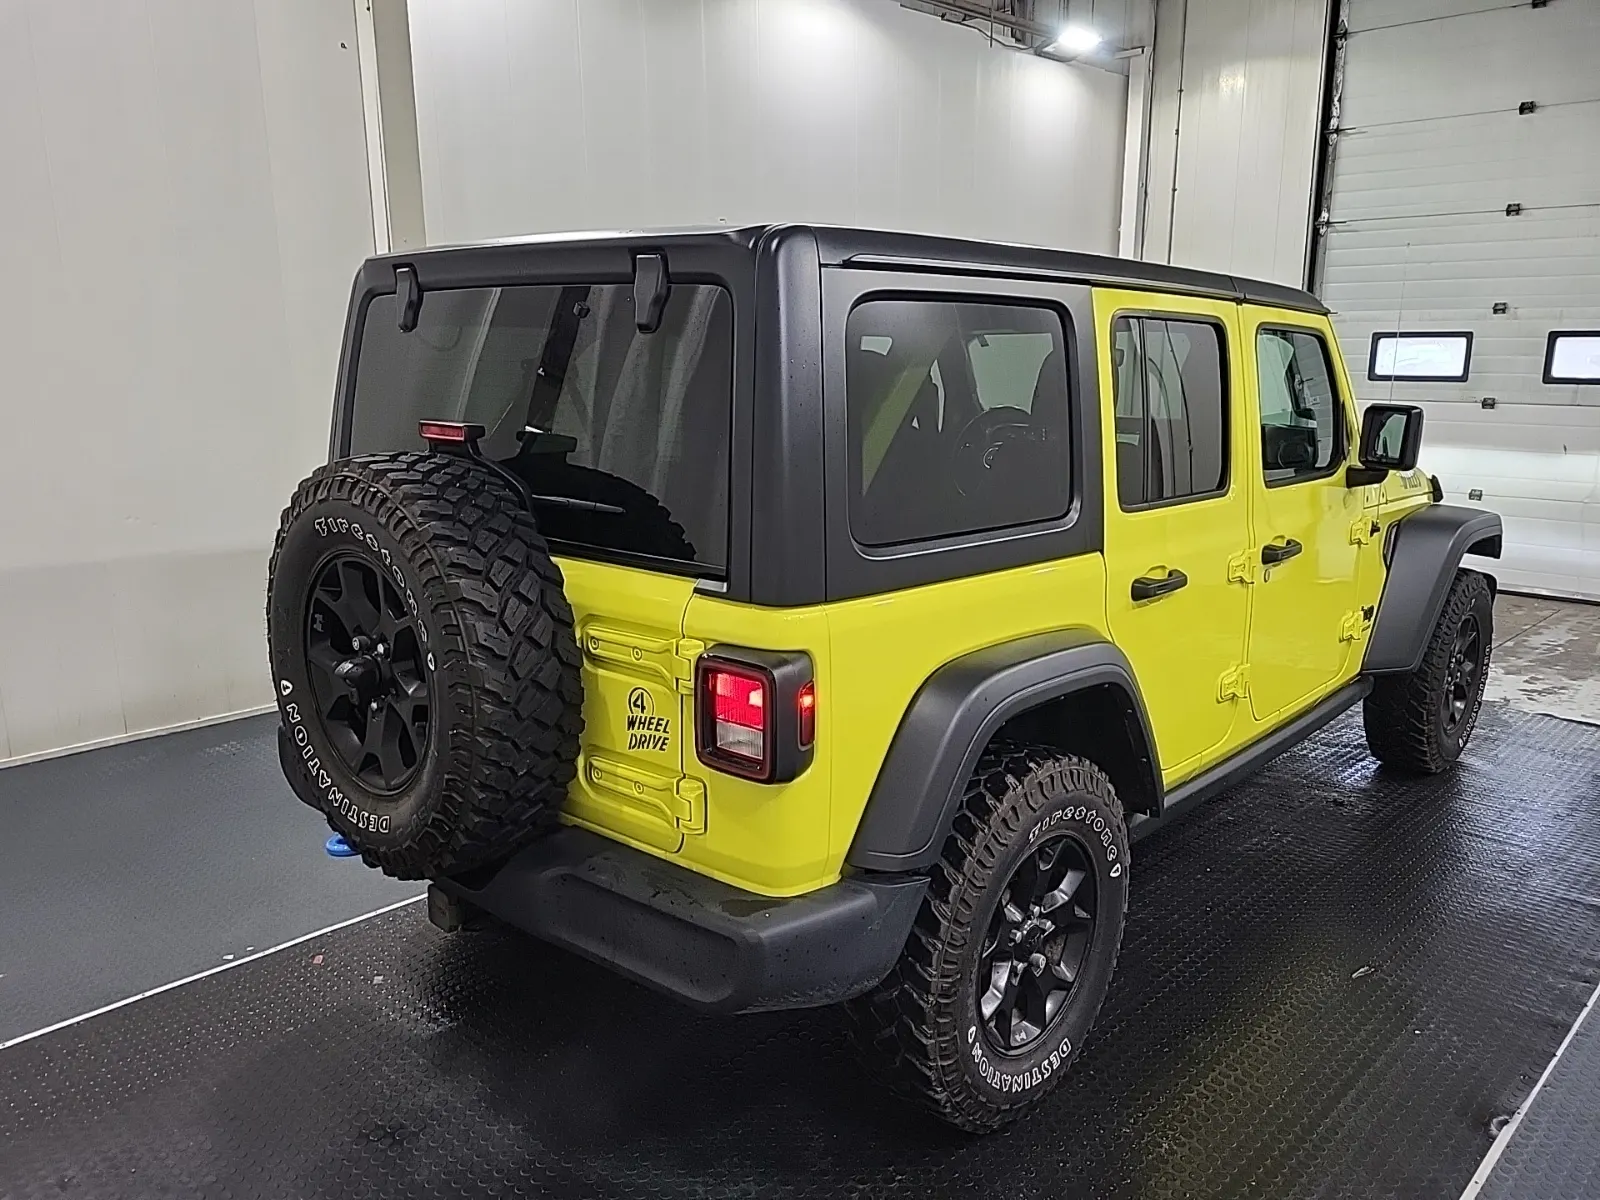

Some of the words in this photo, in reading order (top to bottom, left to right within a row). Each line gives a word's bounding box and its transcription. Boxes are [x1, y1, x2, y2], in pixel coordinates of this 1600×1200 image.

[314, 516, 428, 643] Firestone
[626, 714, 671, 734] WHEEL
[627, 732, 670, 752] DRIVE
[286, 702, 391, 834] DESTINATION
[1028, 806, 1118, 862] Firestone
[971, 1037, 1072, 1093] DESTINATION
